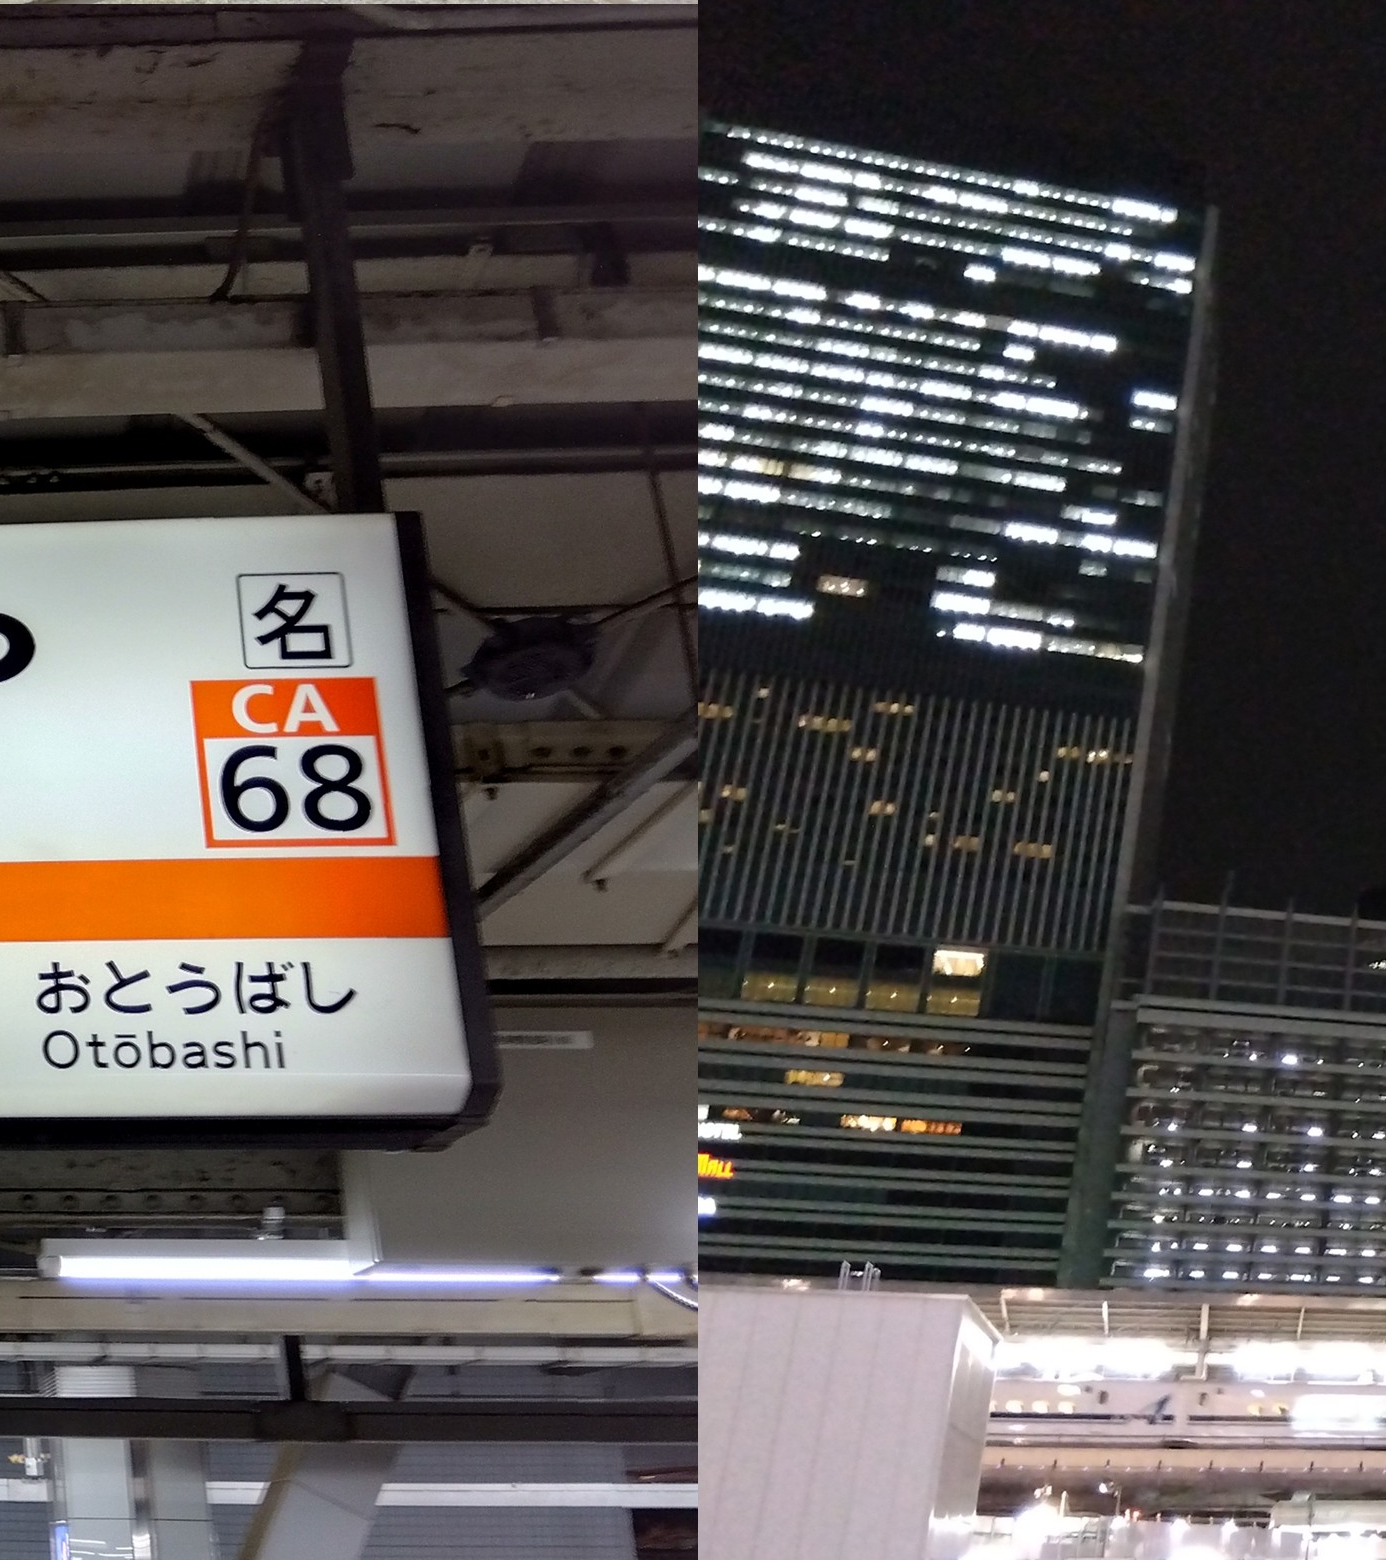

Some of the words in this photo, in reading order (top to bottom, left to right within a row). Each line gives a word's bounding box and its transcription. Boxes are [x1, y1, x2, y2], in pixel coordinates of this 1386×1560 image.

[252, 583, 335, 661] 名
[232, 683, 339, 734] CA
[218, 743, 373, 834] 68
[35, 960, 357, 1016] おとうばし
[42, 1029, 286, 1070] Otōbashi
